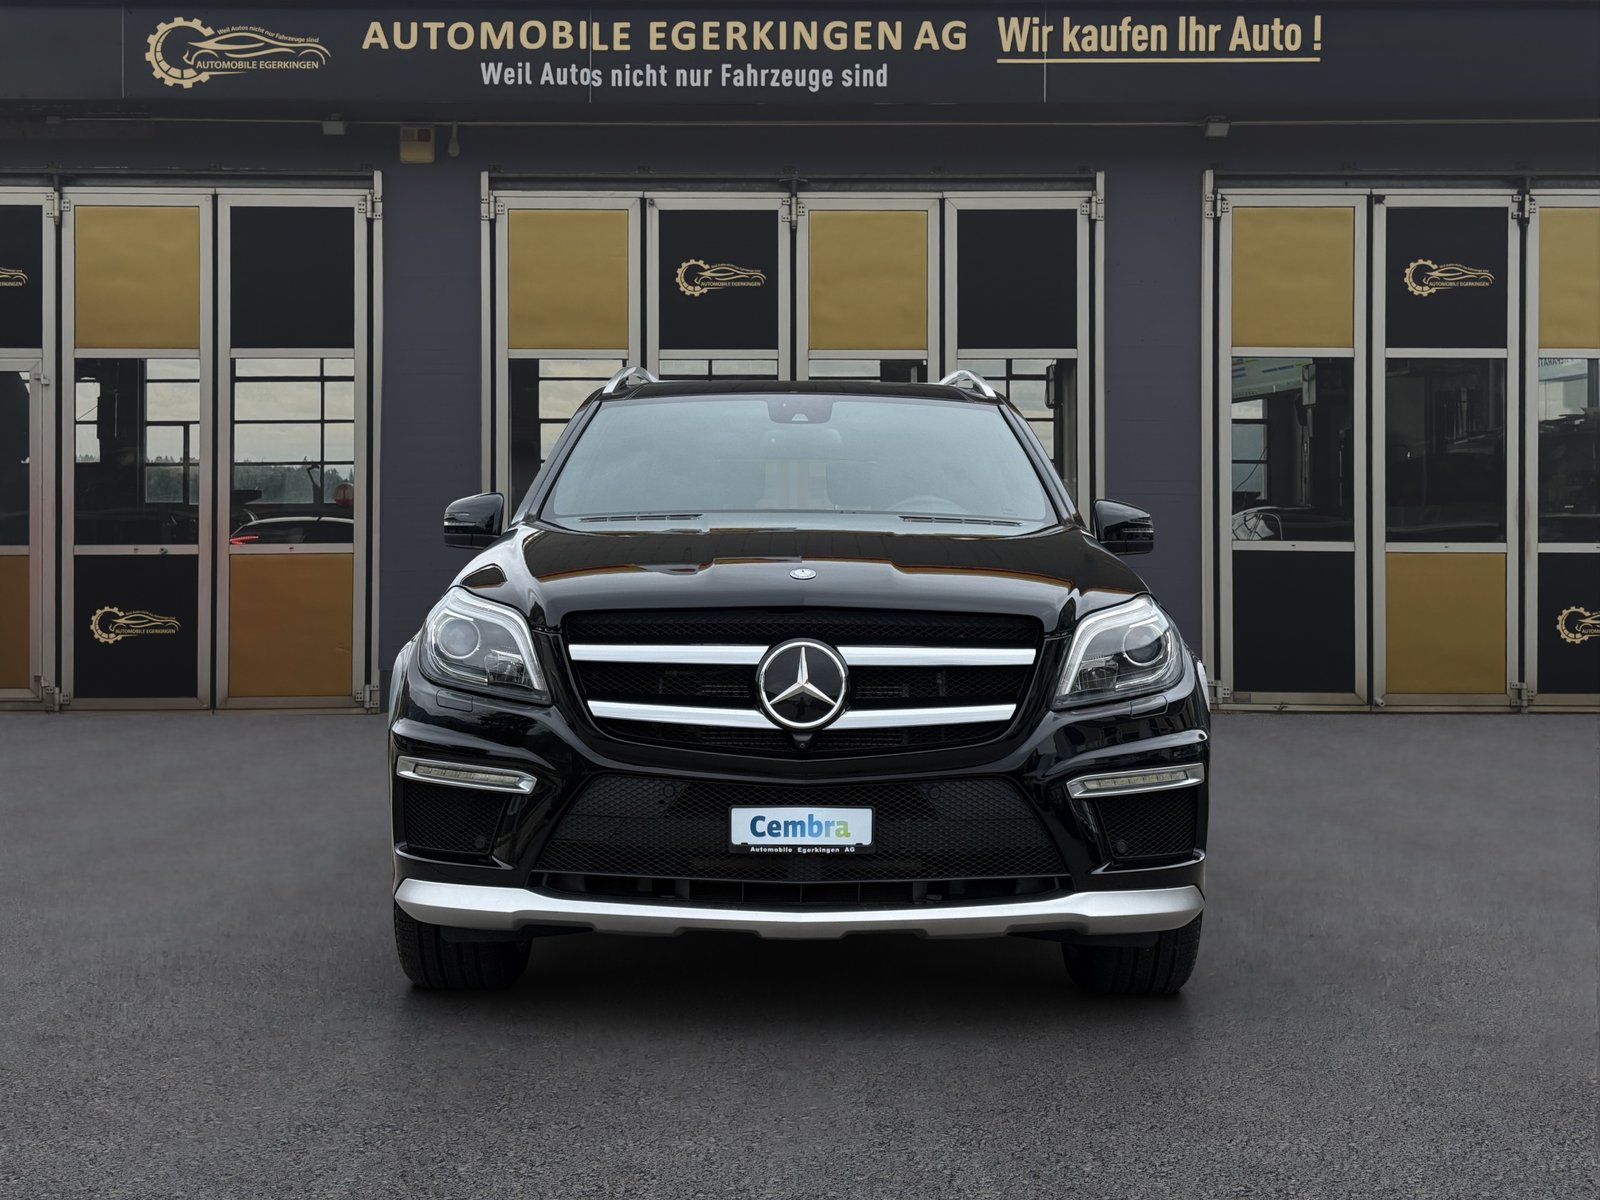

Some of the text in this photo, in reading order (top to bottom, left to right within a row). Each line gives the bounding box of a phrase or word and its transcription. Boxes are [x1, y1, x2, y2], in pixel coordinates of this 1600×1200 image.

[361, 20, 967, 51] AUTOMOBILE EGERKINGEN AG
[997, 16, 1054, 52] Wir
[1062, 16, 1168, 52] kaufen
[1178, 15, 1222, 52] Ihr
[1228, 15, 1302, 52] Auto
[196, 60, 319, 70] AUTOMOBILE EGERKINGEN
[480, 62, 888, 93] Weil Autos nicht nur Fahrzeuge sind
[750, 813, 851, 838] Cembra
